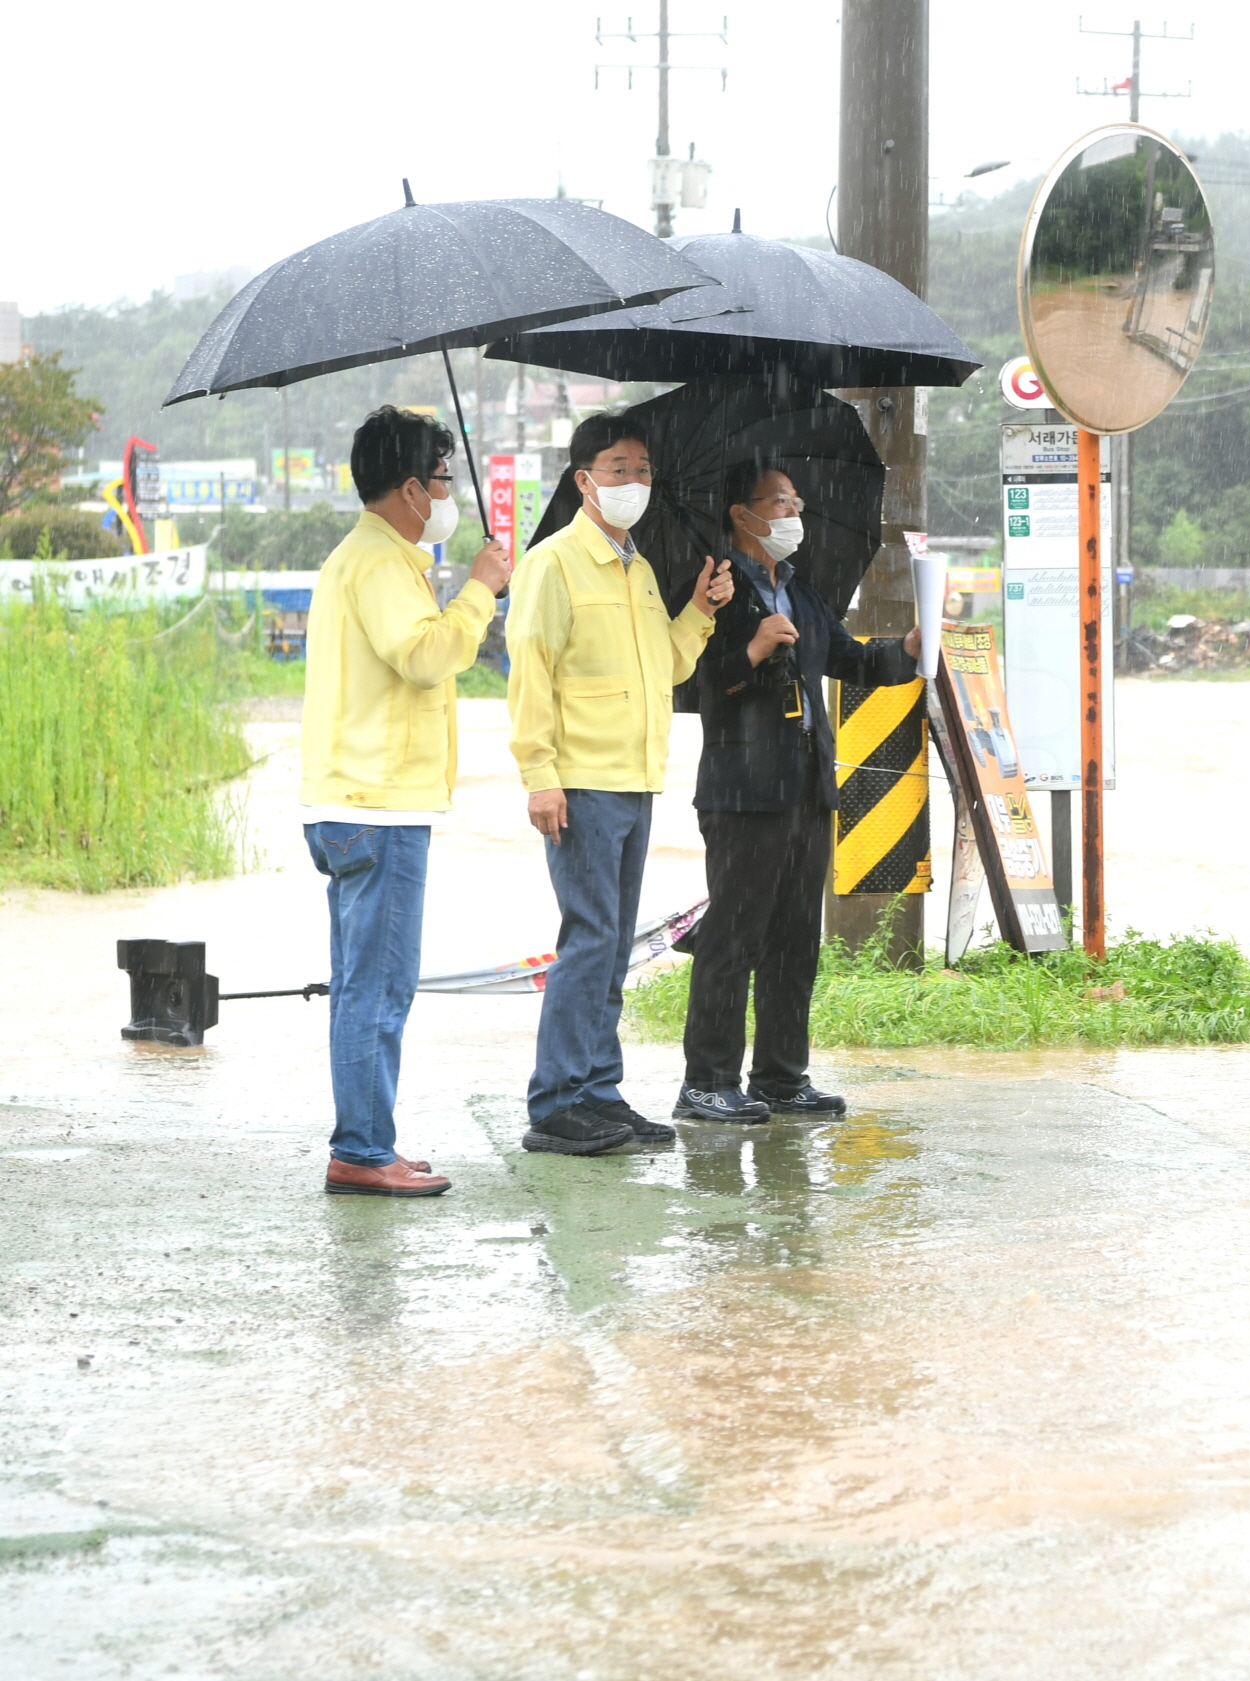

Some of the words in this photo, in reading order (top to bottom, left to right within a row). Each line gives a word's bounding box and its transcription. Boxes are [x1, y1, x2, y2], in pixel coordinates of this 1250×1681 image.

[1009, 489, 1027, 499] 123
[1009, 516, 1029, 527] 123-1
[1008, 584, 1023, 592] 737
